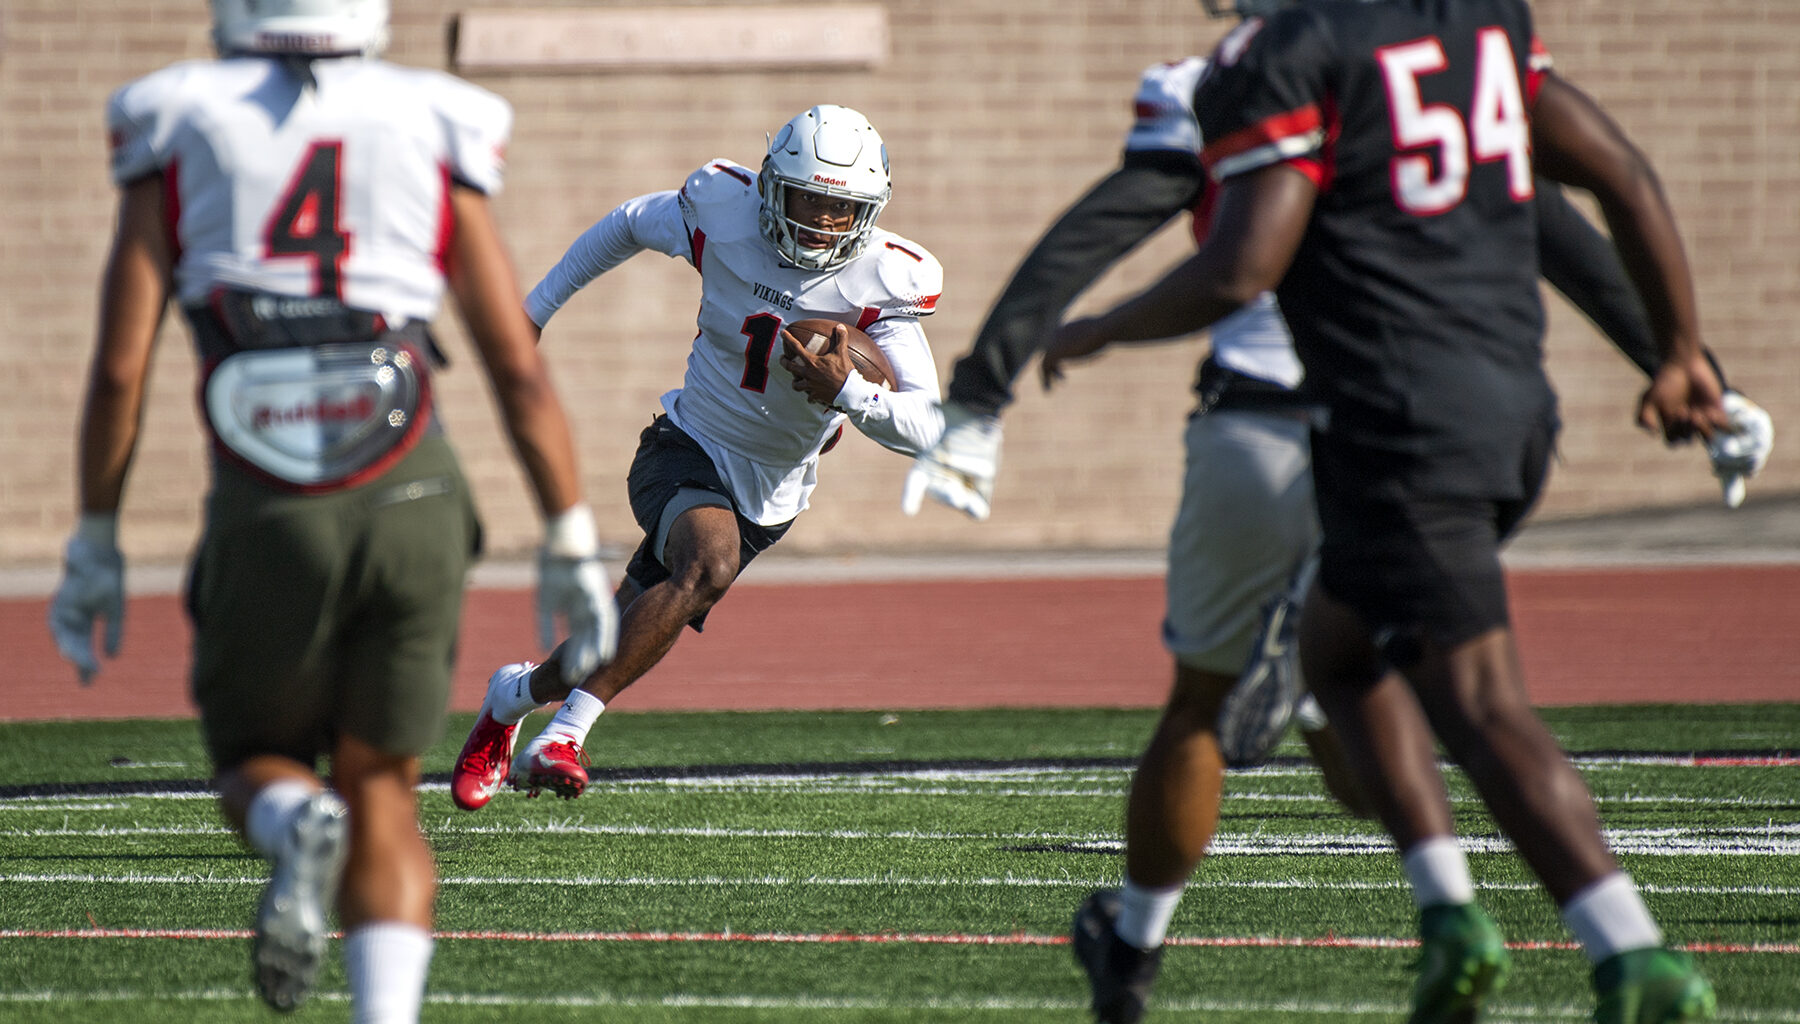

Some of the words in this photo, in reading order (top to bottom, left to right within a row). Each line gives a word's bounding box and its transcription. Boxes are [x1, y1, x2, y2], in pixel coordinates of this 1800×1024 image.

[1374, 25, 1535, 216] 54
[713, 164, 752, 186] 1
[813, 174, 847, 187] Riddell
[260, 138, 352, 302] 4
[885, 242, 923, 262] 1
[753, 282, 795, 311] VIKINGS
[740, 312, 782, 394] 1
